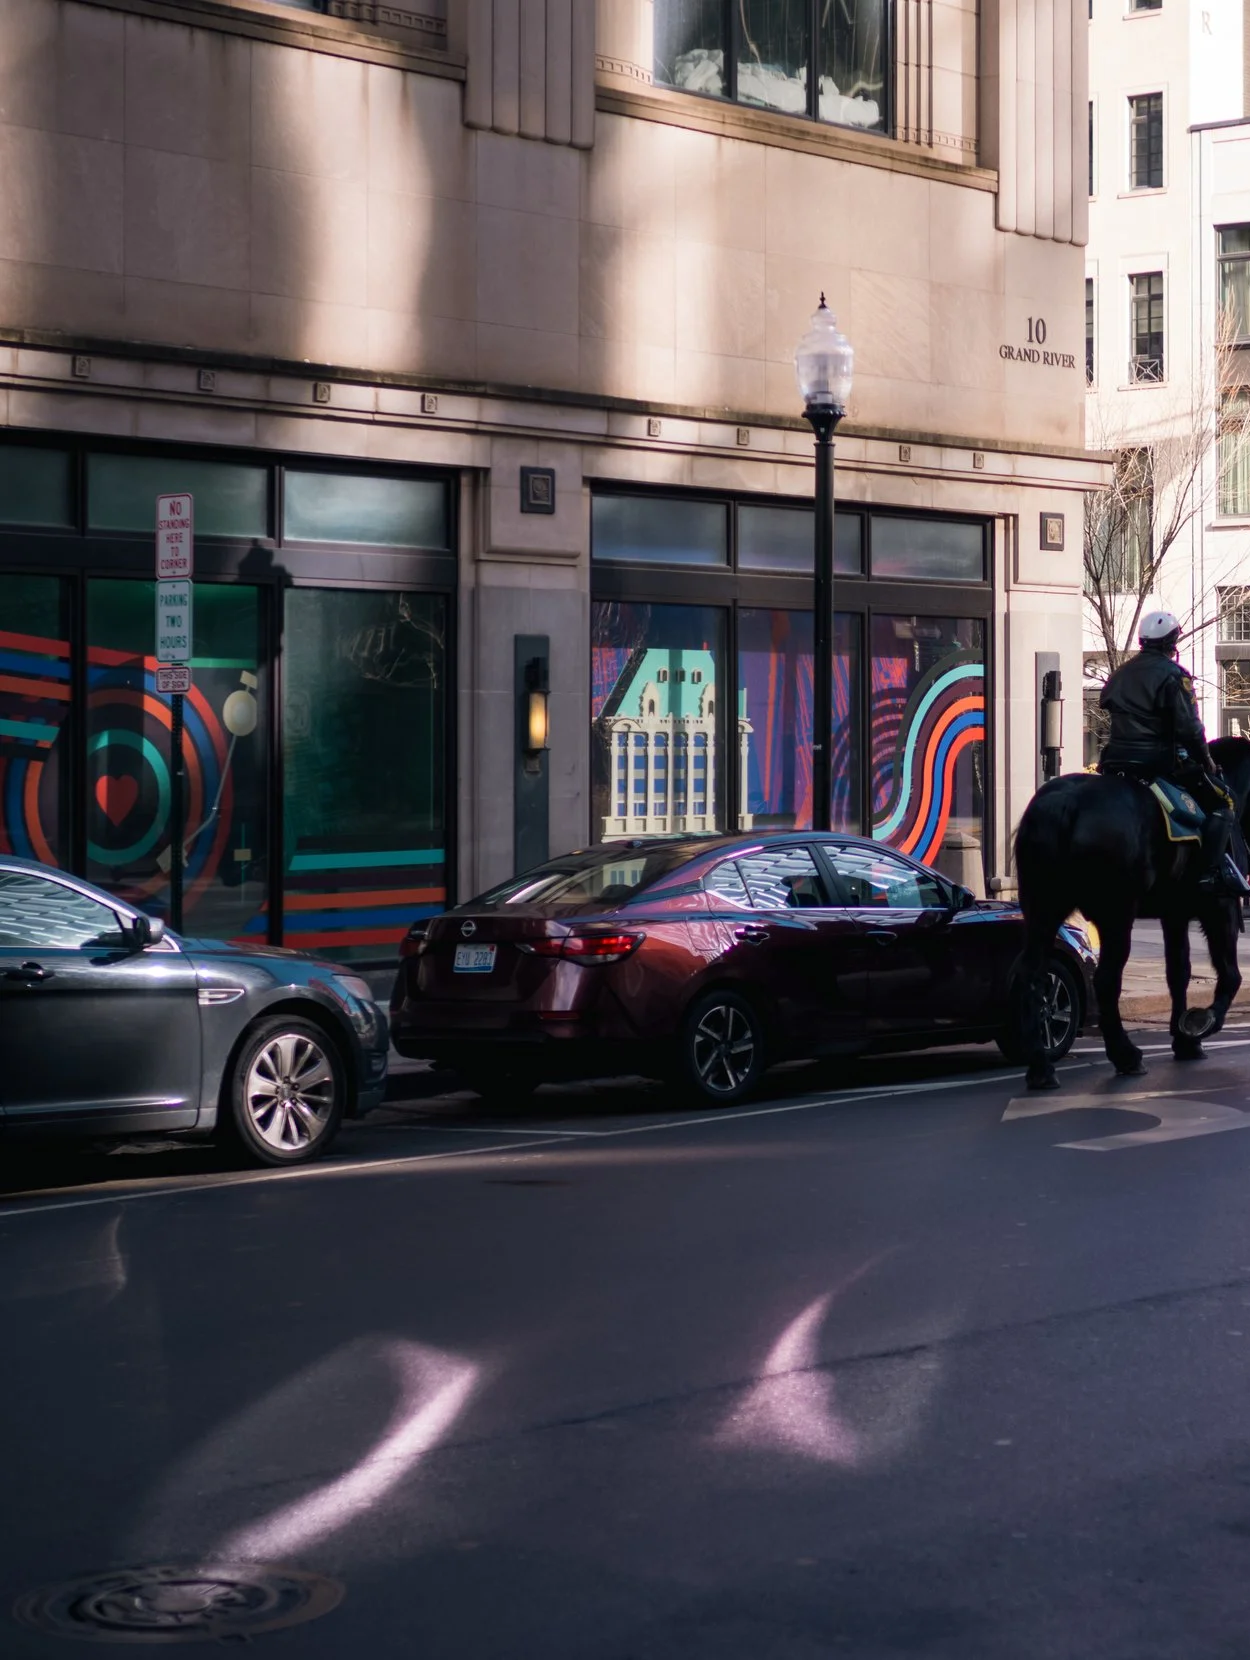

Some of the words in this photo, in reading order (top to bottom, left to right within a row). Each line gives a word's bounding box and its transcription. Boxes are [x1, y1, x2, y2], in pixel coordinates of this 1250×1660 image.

[1026, 316, 1047, 345] 10
[999, 344, 1040, 363] GRAND
[1042, 350, 1076, 369] RIVER
[169, 501, 182, 516] NO
[158, 518, 191, 530] STANDING
[165, 532, 183, 544] HERE
[170, 546, 180, 557] TO
[160, 558, 188, 570] CORNER
[159, 593, 188, 607] PARKING
[165, 615, 183, 628] TWO
[159, 635, 187, 649] HOURS
[159, 671, 173, 679] THIS
[174, 670, 187, 679] SIDE
[162, 680, 170, 689] OF
[171, 680, 185, 689] SIGN
